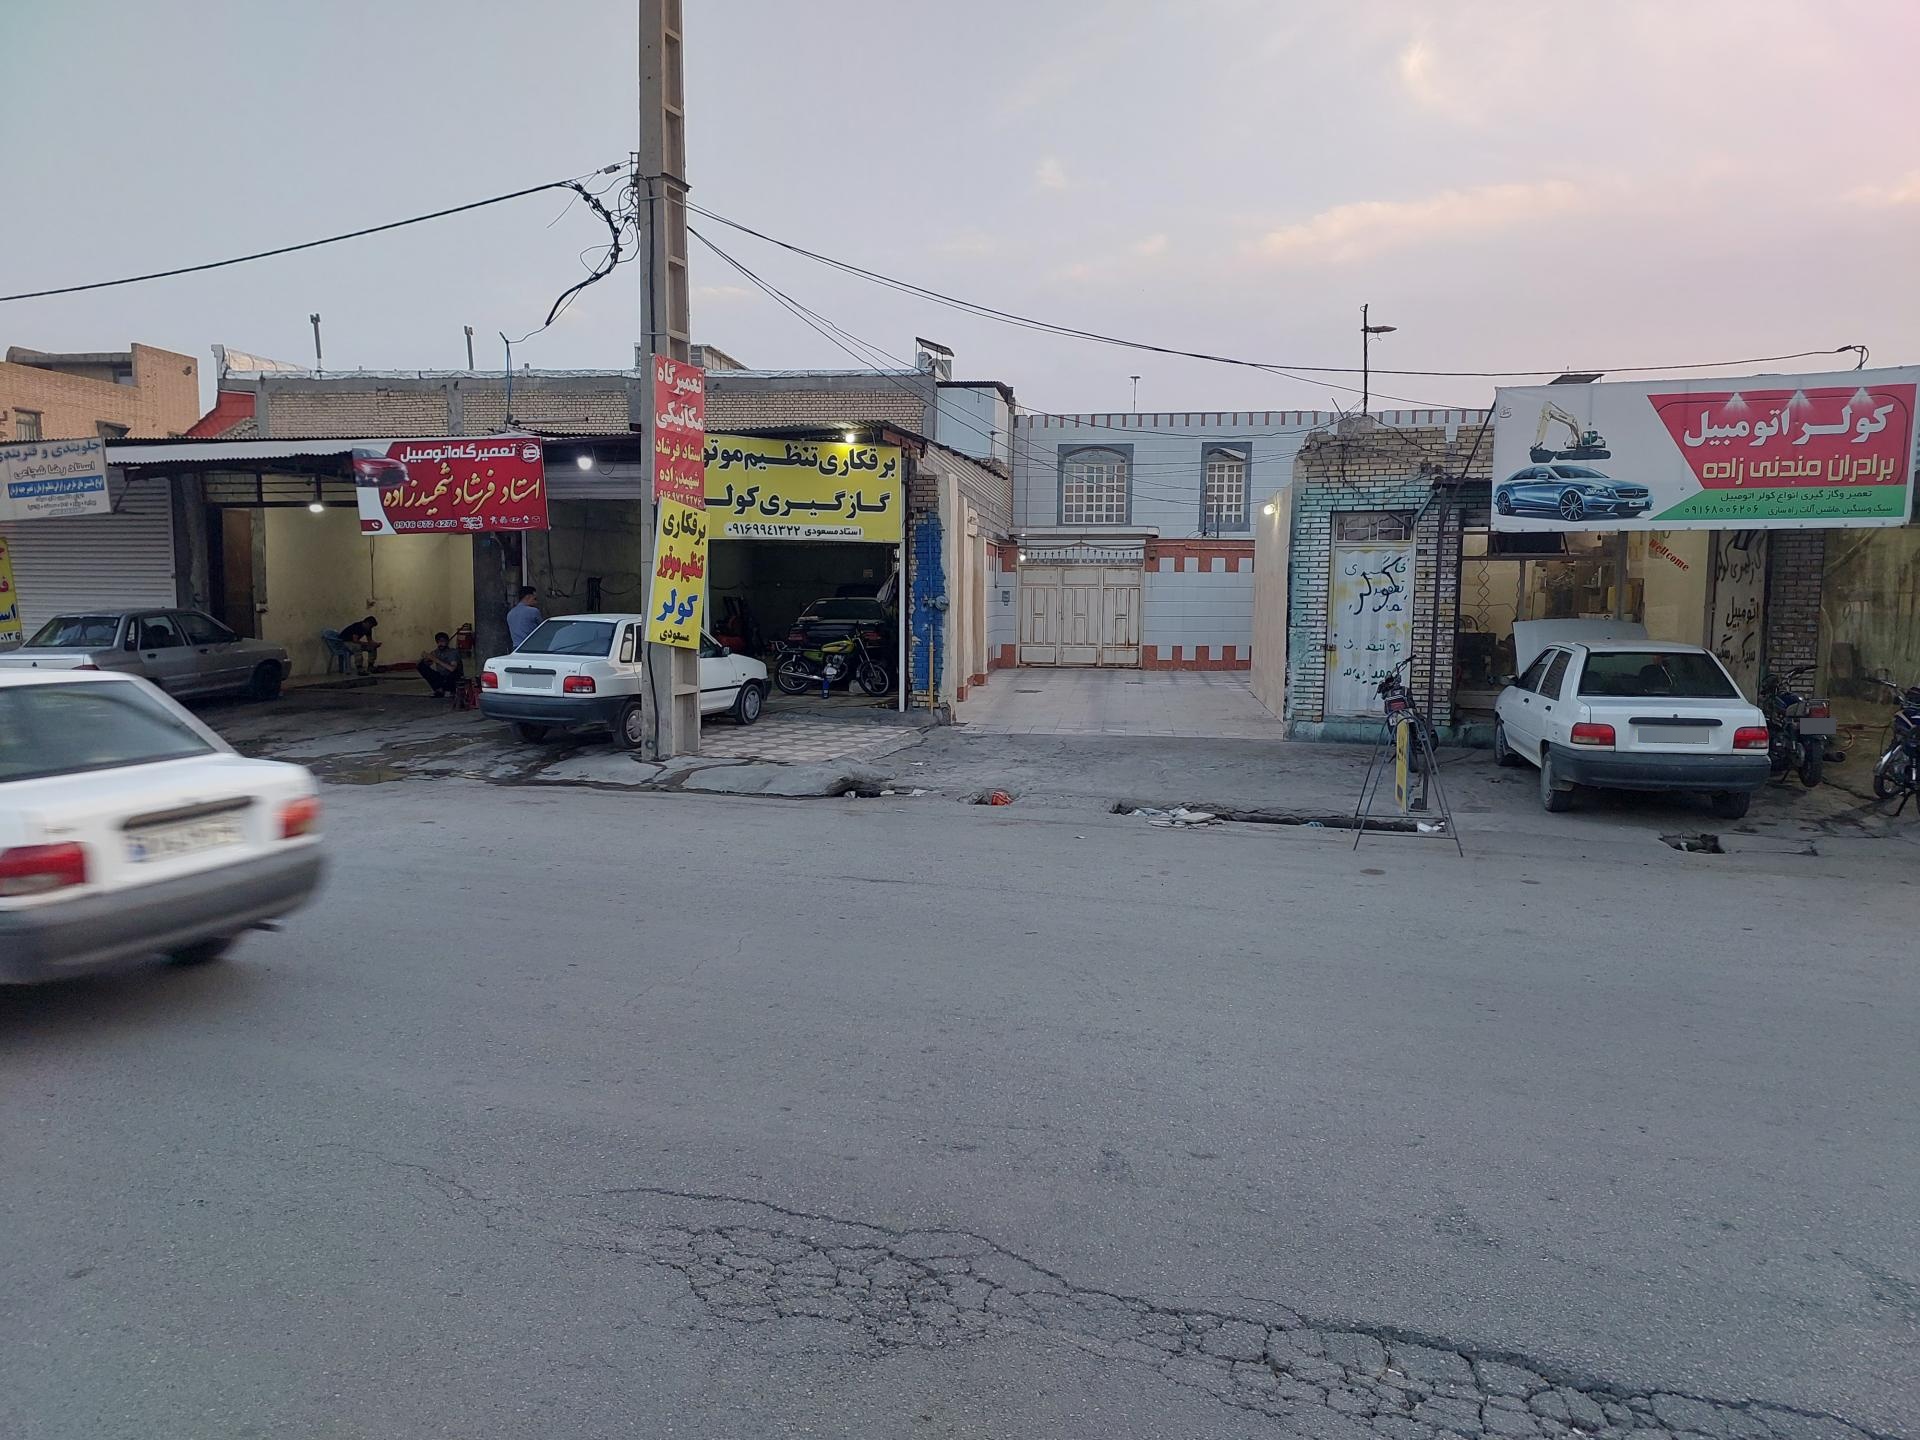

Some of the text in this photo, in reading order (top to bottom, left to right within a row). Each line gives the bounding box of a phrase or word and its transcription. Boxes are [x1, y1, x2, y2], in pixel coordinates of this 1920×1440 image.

[1683, 404, 1894, 447] کولر اتومبیل
[41, 448, 48, 459] و
[50, 440, 101, 457] جلوبندی
[400, 445, 516, 463] تعمیرگاه اتومبیل
[655, 437, 680, 462] فرشاد
[704, 439, 896, 478] برقکاری تنظیم موتو
[14, 461, 95, 479] استاد رضا شجاعی
[1702, 453, 1895, 485] برادران مندنی زاده
[452, 469, 496, 514] فرشاد
[500, 477, 540, 504] استاد
[704, 484, 760, 515] کول
[1721, 493, 1754, 502] اتومبیل
[1758, 492, 1775, 501] کولر
[1777, 492, 1799, 503] انواع
[1800, 491, 1823, 501] گیری
[1847, 490, 1872, 500] تعمیر
[1872, 505, 1893, 513] سبک
[663, 510, 706, 545] برقکاری
[805, 528, 839, 536] مسعودی
[839, 528, 861, 536] استاد
[1649, 539, 1689, 571] Wellcome
[680, 551, 704, 582] تنظیم
[656, 588, 698, 625] کولر
[1726, 596, 1759, 628] اتومبیل
[659, 629, 690, 643] مسعودی
